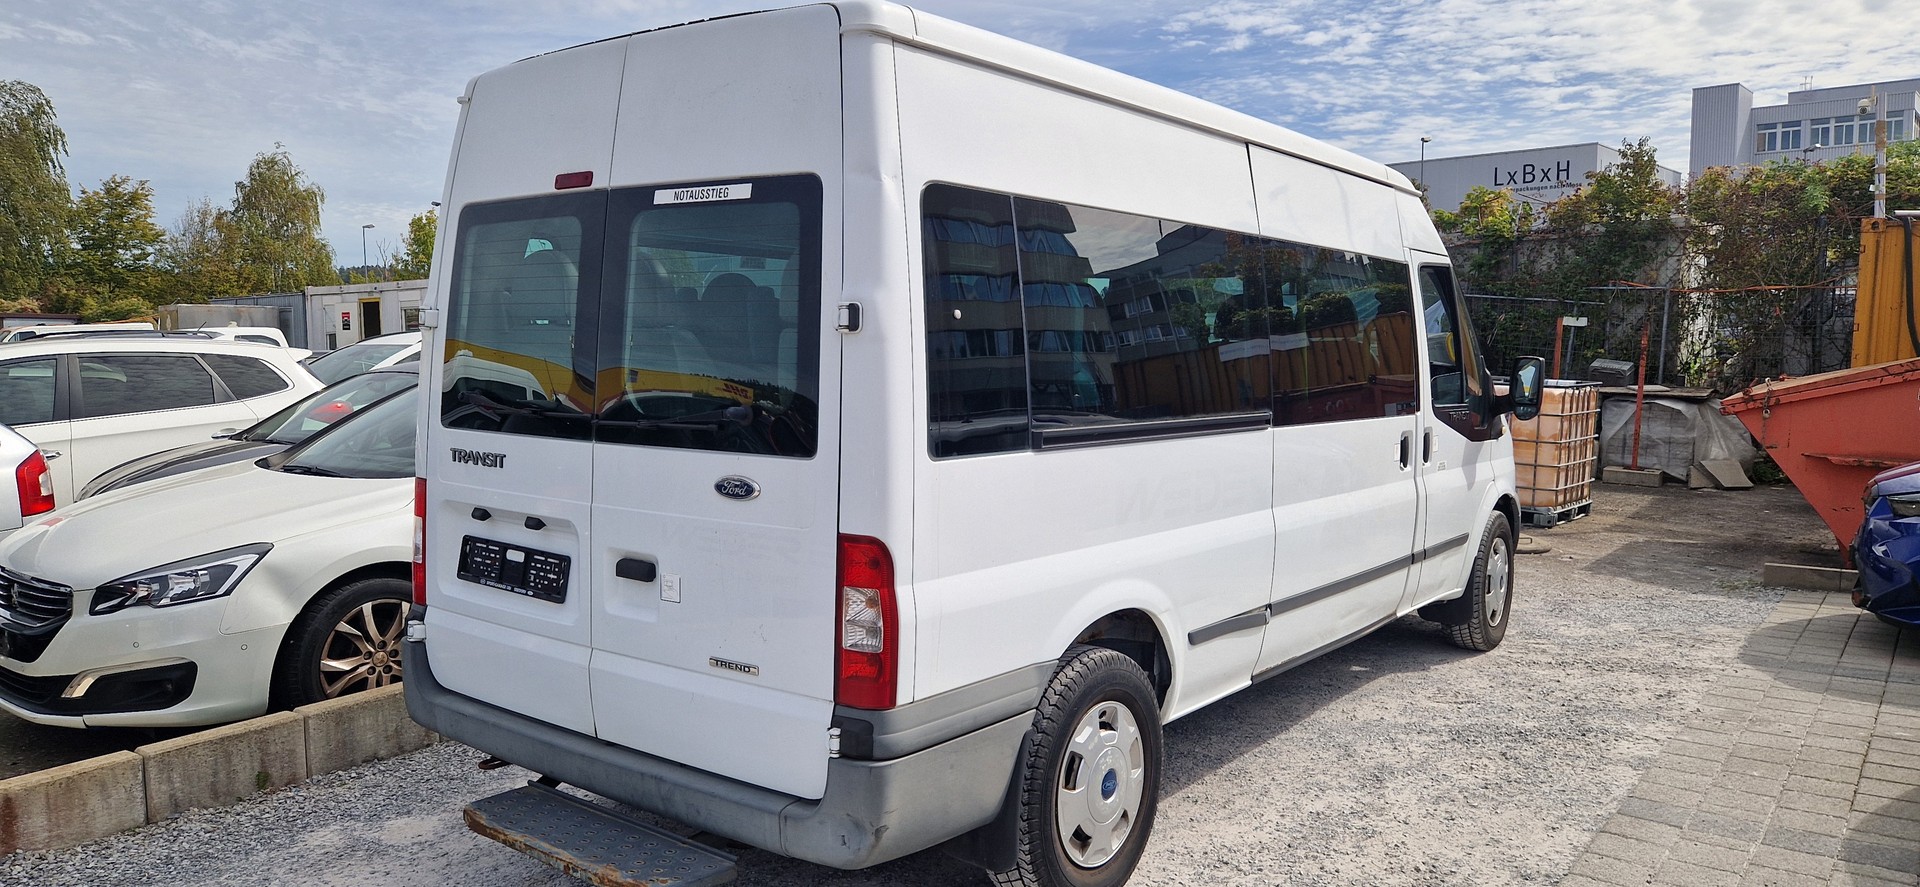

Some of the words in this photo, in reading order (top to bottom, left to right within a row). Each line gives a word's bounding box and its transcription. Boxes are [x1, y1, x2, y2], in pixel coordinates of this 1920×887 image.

[673, 187, 730, 201] NOTAUSSTIEG
[450, 447, 507, 468] TRANSIT
[721, 480, 748, 496] Ford
[714, 660, 751, 673] TREND
